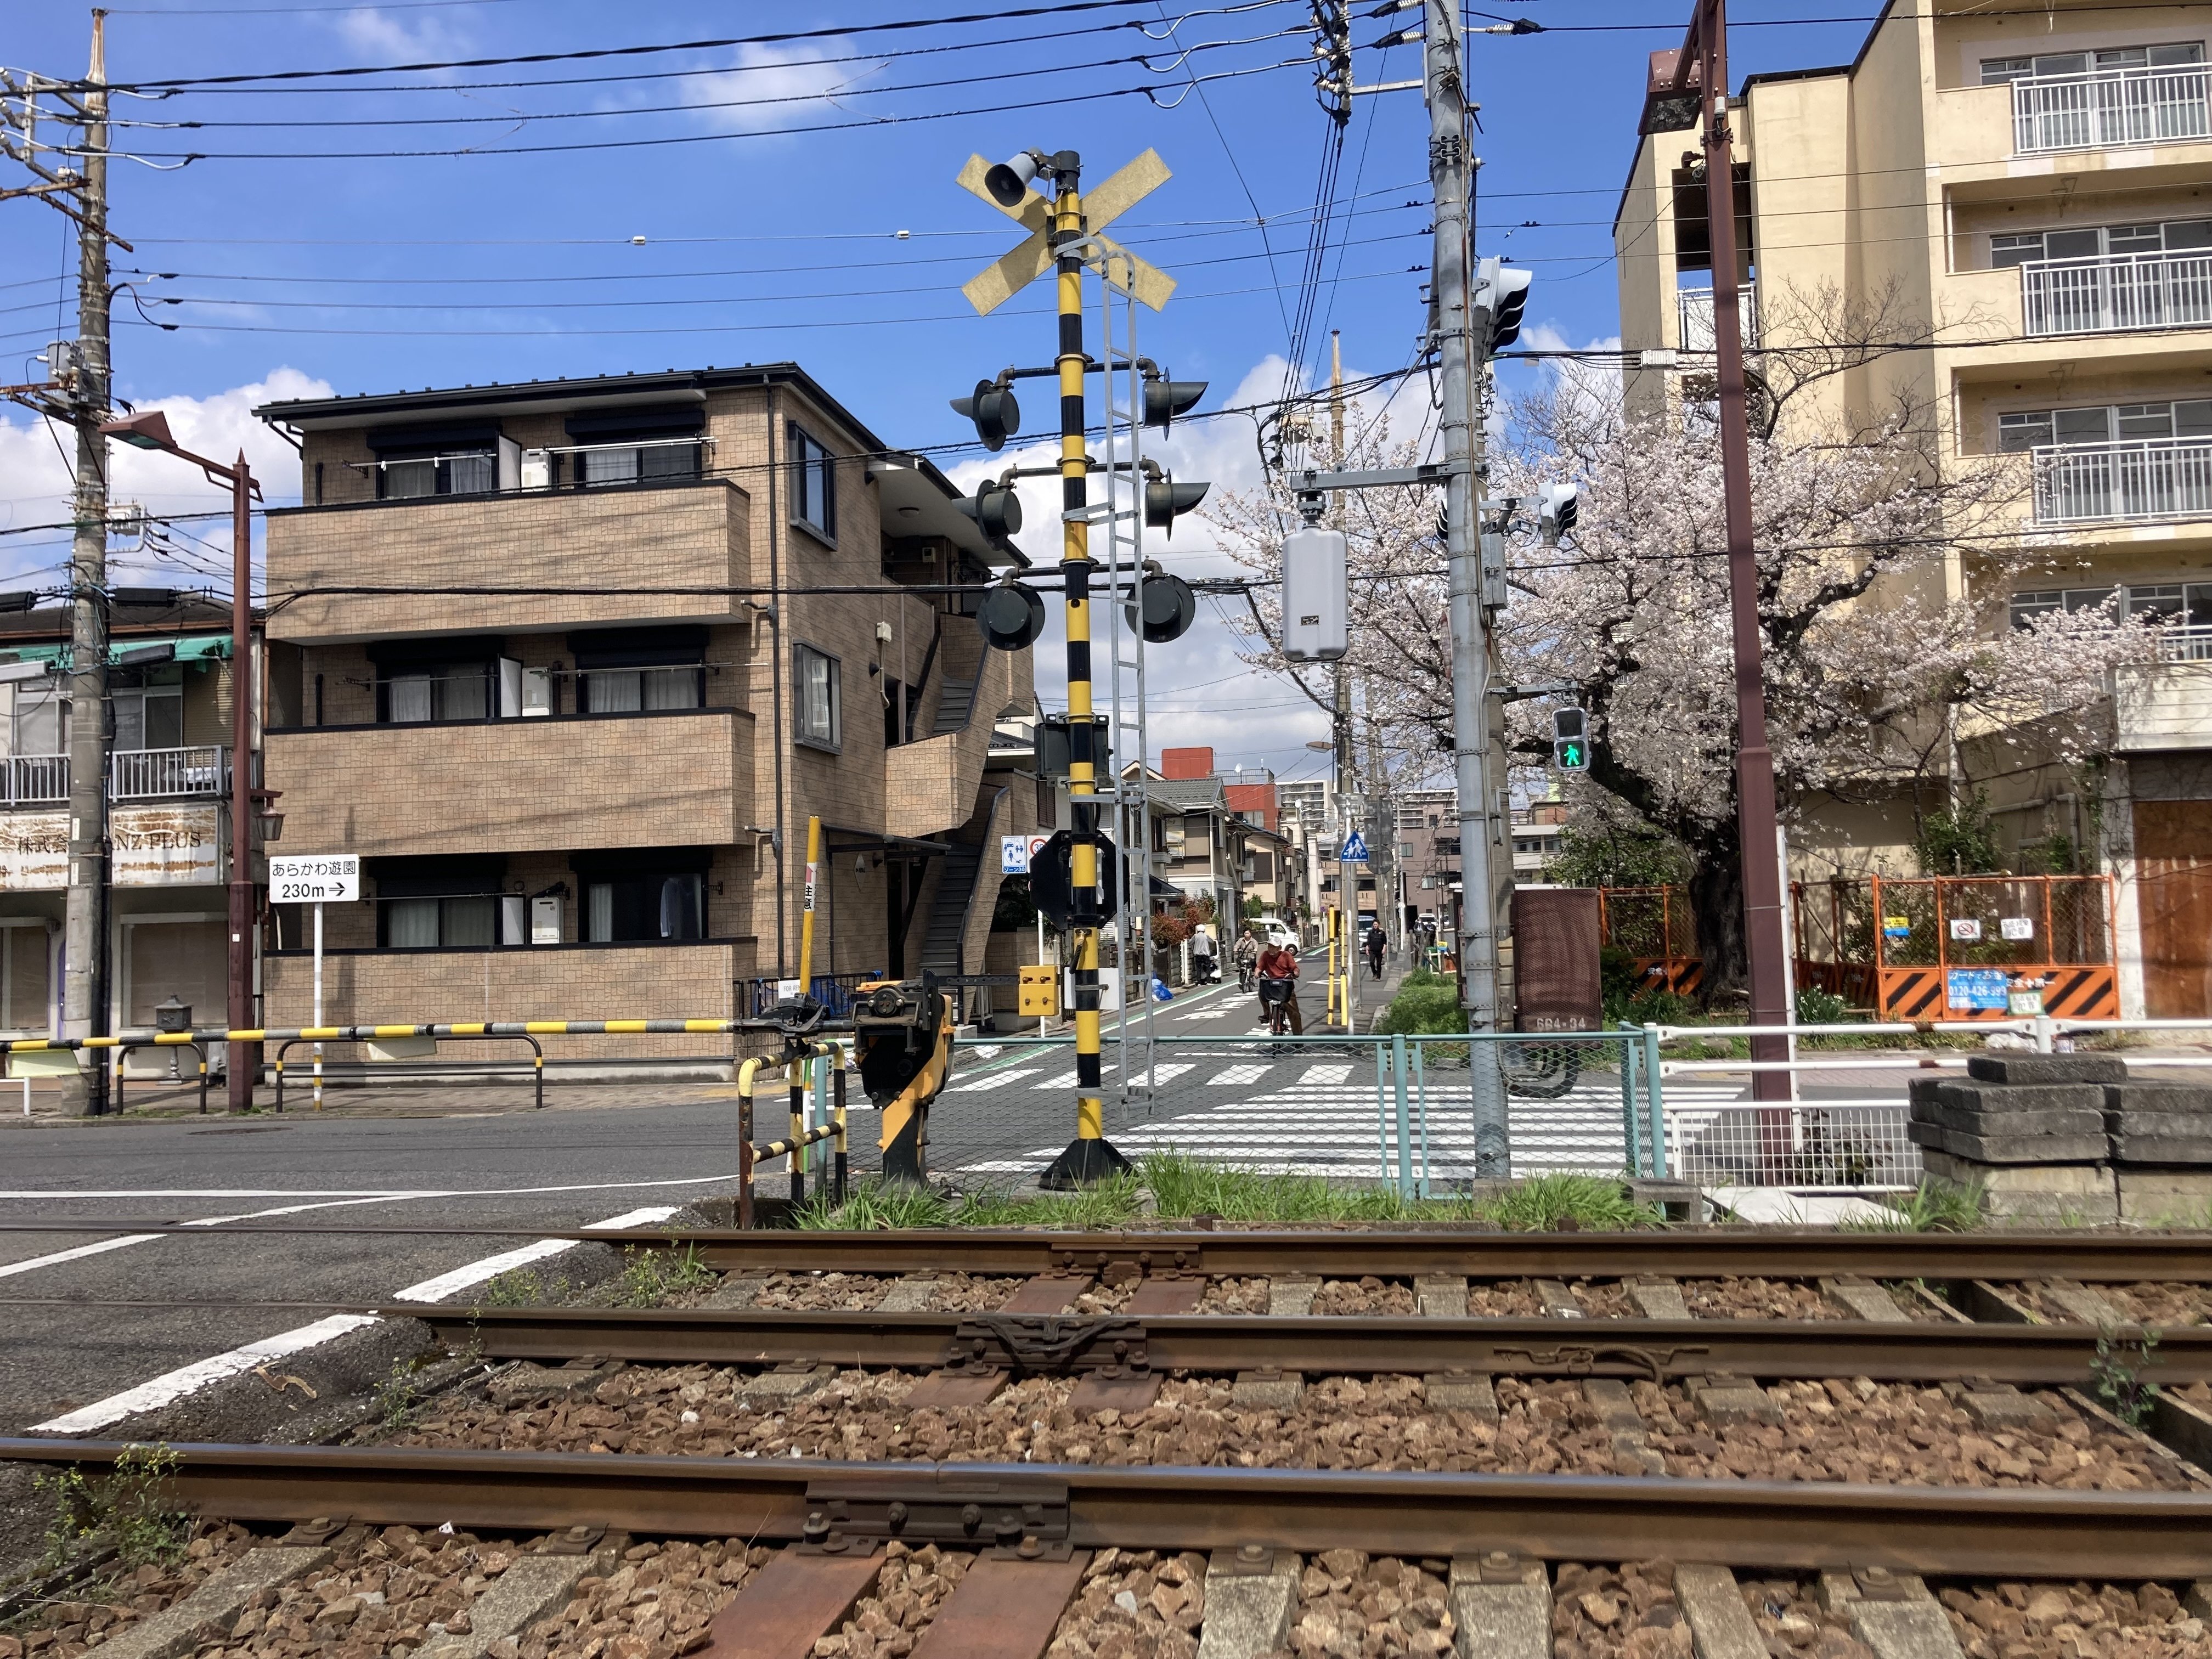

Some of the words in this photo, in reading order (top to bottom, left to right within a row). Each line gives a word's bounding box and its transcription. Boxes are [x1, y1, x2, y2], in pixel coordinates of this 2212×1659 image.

[150, 832, 201, 849] PLUS
[272, 861, 356, 877] あらかわ遊園
[282, 883, 324, 898] 230m
